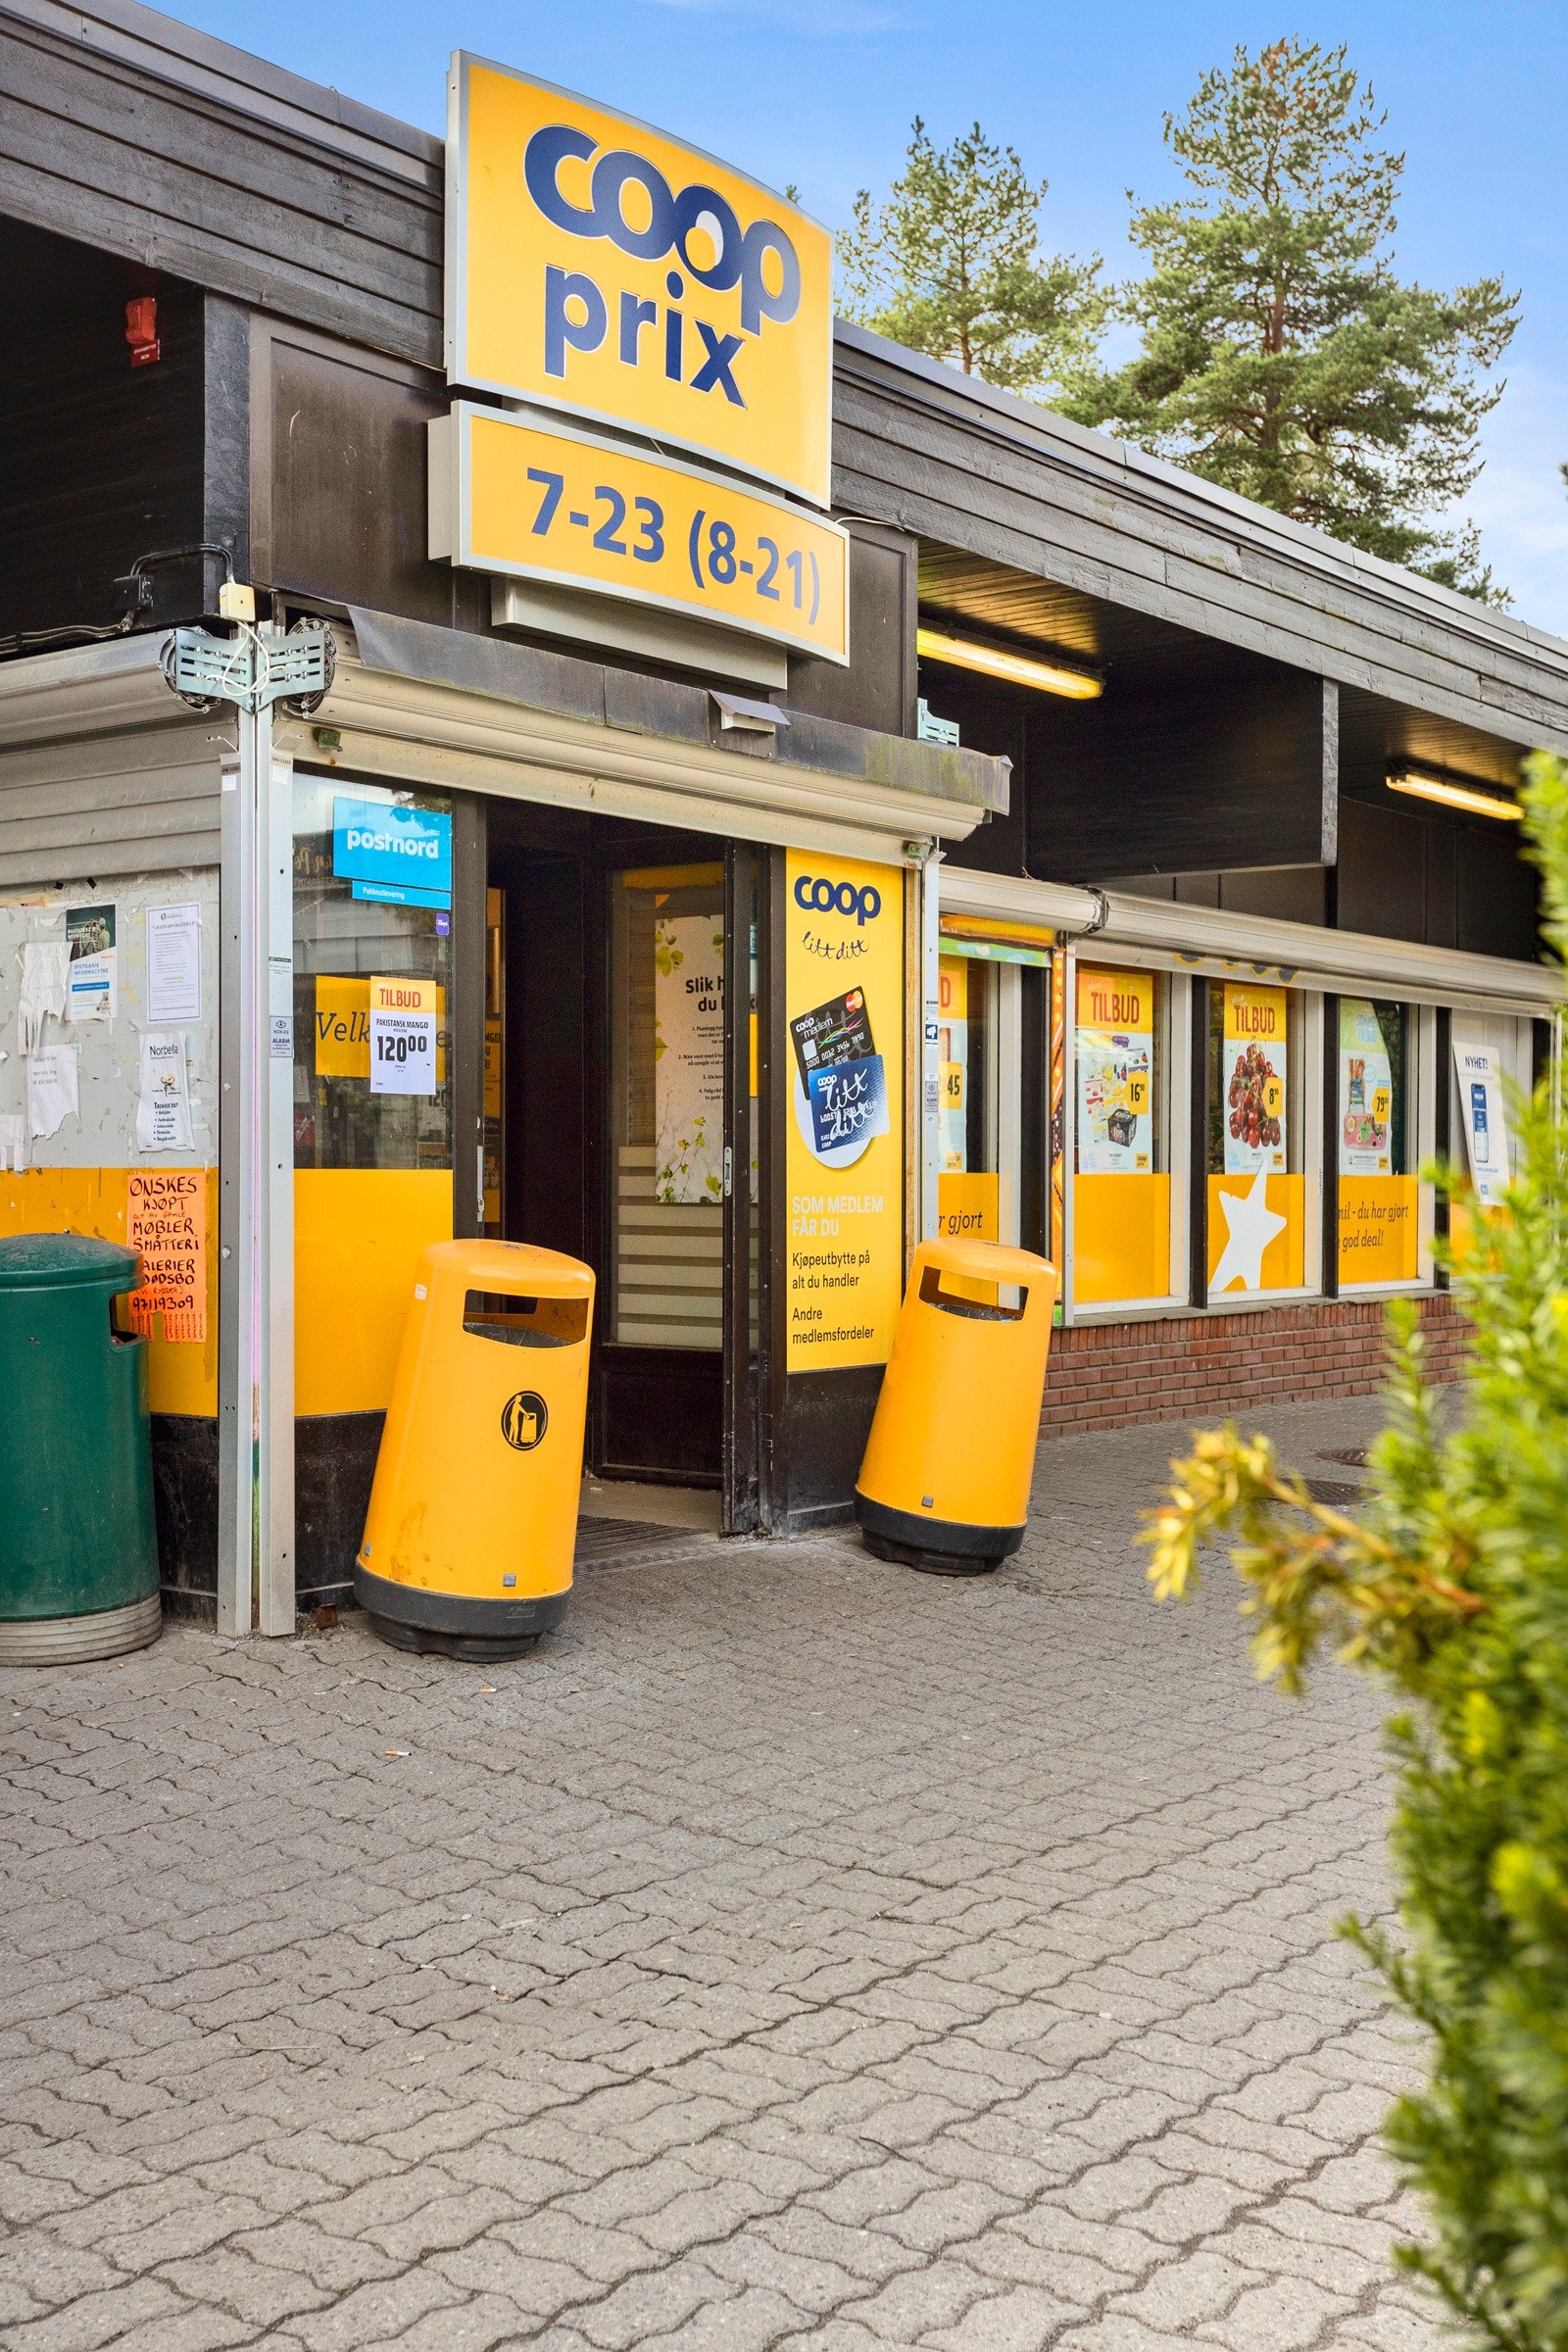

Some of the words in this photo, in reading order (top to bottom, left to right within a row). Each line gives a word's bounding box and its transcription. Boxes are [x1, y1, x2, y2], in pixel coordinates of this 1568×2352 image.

[524, 123, 802, 337] coop
[544, 263, 748, 411] prix
[525, 466, 665, 564] 7-23
[689, 509, 821, 625] (8-21)
[347, 829, 439, 859] postnord
[362, 886, 406, 900] Pakkeutlevering
[794, 875, 881, 926] coop
[802, 930, 836, 959] litt
[836, 939, 869, 959] ditt
[685, 976, 713, 995] Slik
[379, 988, 421, 1008] TILBUD
[698, 997, 717, 1012] du
[1091, 991, 1140, 1024] TILBUD
[376, 1018, 406, 1028] PAKISTANSK
[407, 1020, 429, 1029] MANGO
[796, 1017, 814, 1033] coop
[804, 1017, 834, 1040] medlem
[1234, 1004, 1275, 1034] TILBUD
[149, 1044, 178, 1056] Norbella
[1464, 1055, 1489, 1070] NYHET!
[817, 1074, 837, 1087] coop
[129, 1176, 197, 1197] ØNSKES
[143, 1197, 188, 1211] KJØPT
[792, 1196, 824, 1214] SOM
[827, 1196, 884, 1214] MEDLEM
[1357, 1201, 1369, 1219] du
[1371, 1200, 1387, 1218] har
[1388, 1203, 1408, 1223] gjort
[133, 1217, 194, 1236] MØBLER
[792, 1215, 817, 1237] FÅR
[820, 1218, 840, 1237] DU
[948, 1209, 984, 1235] gjort
[1343, 1229, 1359, 1252] god
[1361, 1228, 1384, 1247] deal!
[143, 1258, 195, 1274] ALERIER
[792, 1251, 857, 1270] Kjøpeutbytte
[858, 1250, 870, 1268] på
[792, 1275, 805, 1290] alt
[808, 1274, 820, 1289] du
[822, 1273, 859, 1288] handler
[132, 1295, 194, 1312] 97119309
[792, 1306, 823, 1321] Andre
[792, 1325, 875, 1345] medlemsfordeler
